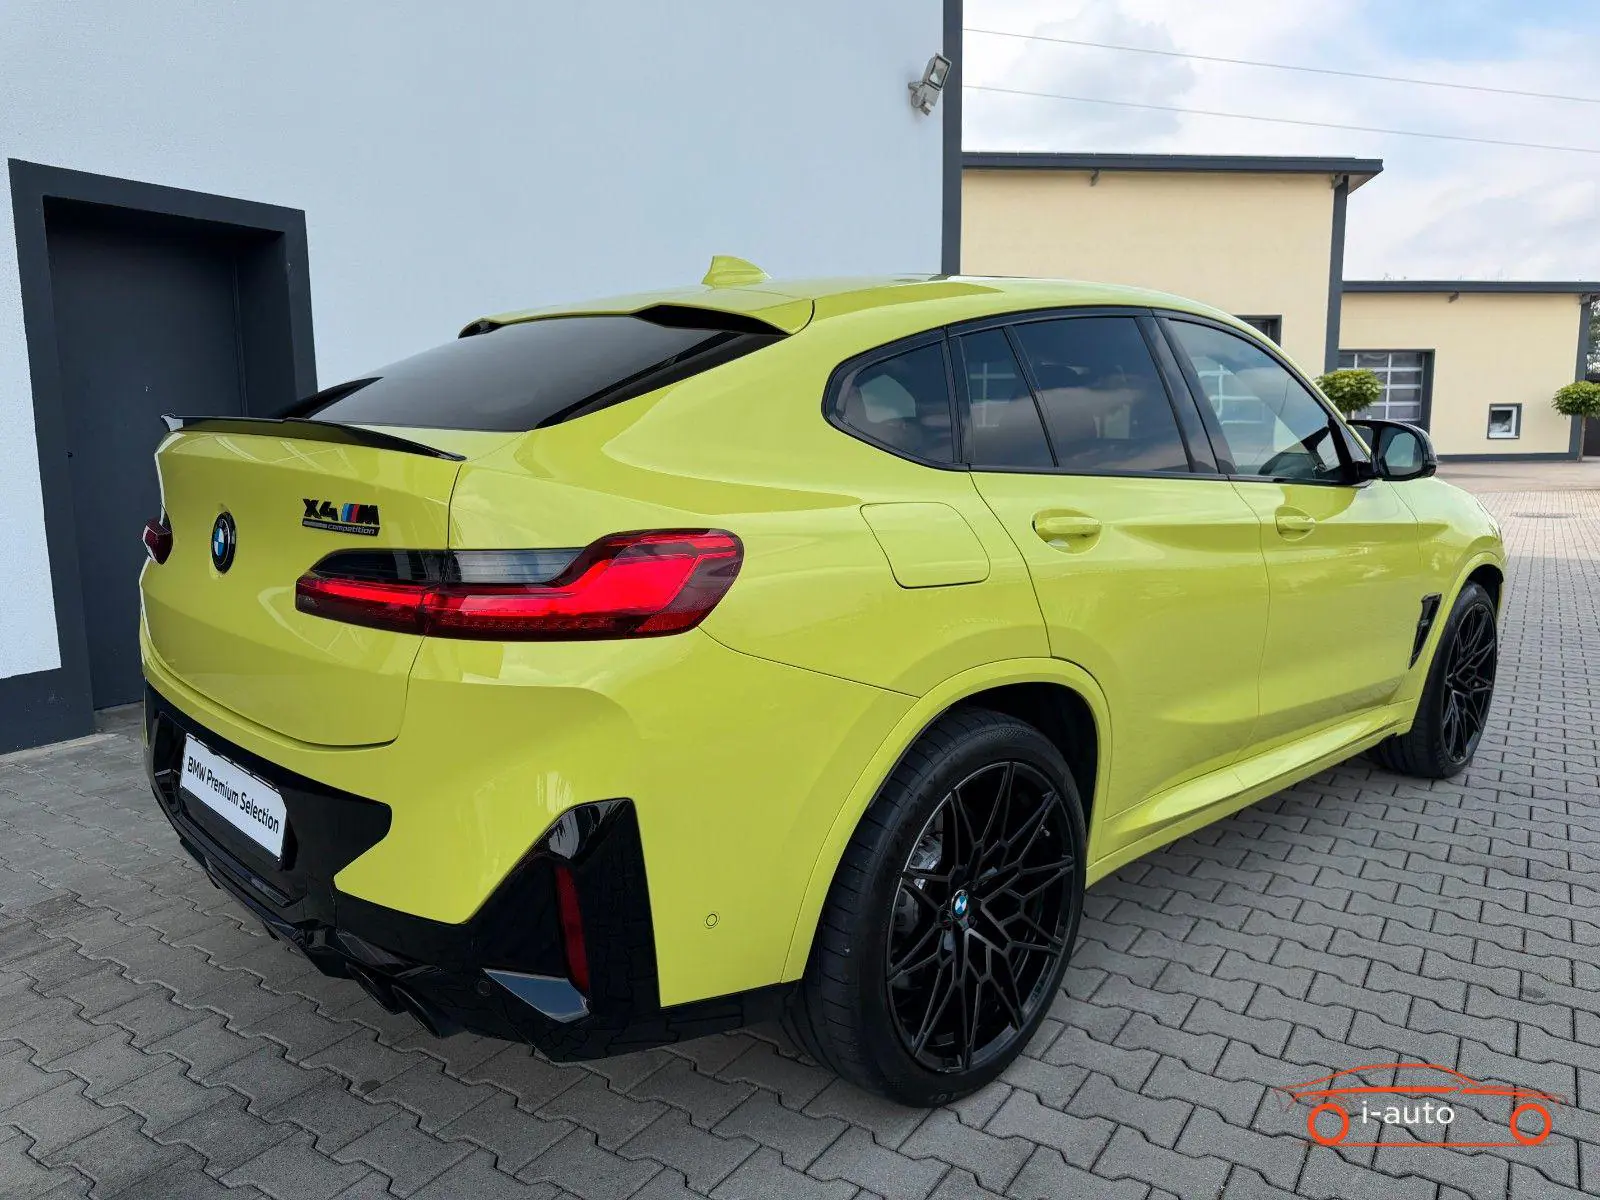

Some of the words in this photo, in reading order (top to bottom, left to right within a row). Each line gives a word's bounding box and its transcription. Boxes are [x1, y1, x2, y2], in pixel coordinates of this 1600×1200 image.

[303, 499, 338, 521] X4
[355, 503, 380, 525] M
[327, 523, 375, 535] competition
[187, 756, 206, 781] BMW
[207, 768, 239, 806] Premium
[239, 791, 279, 834] Selection
